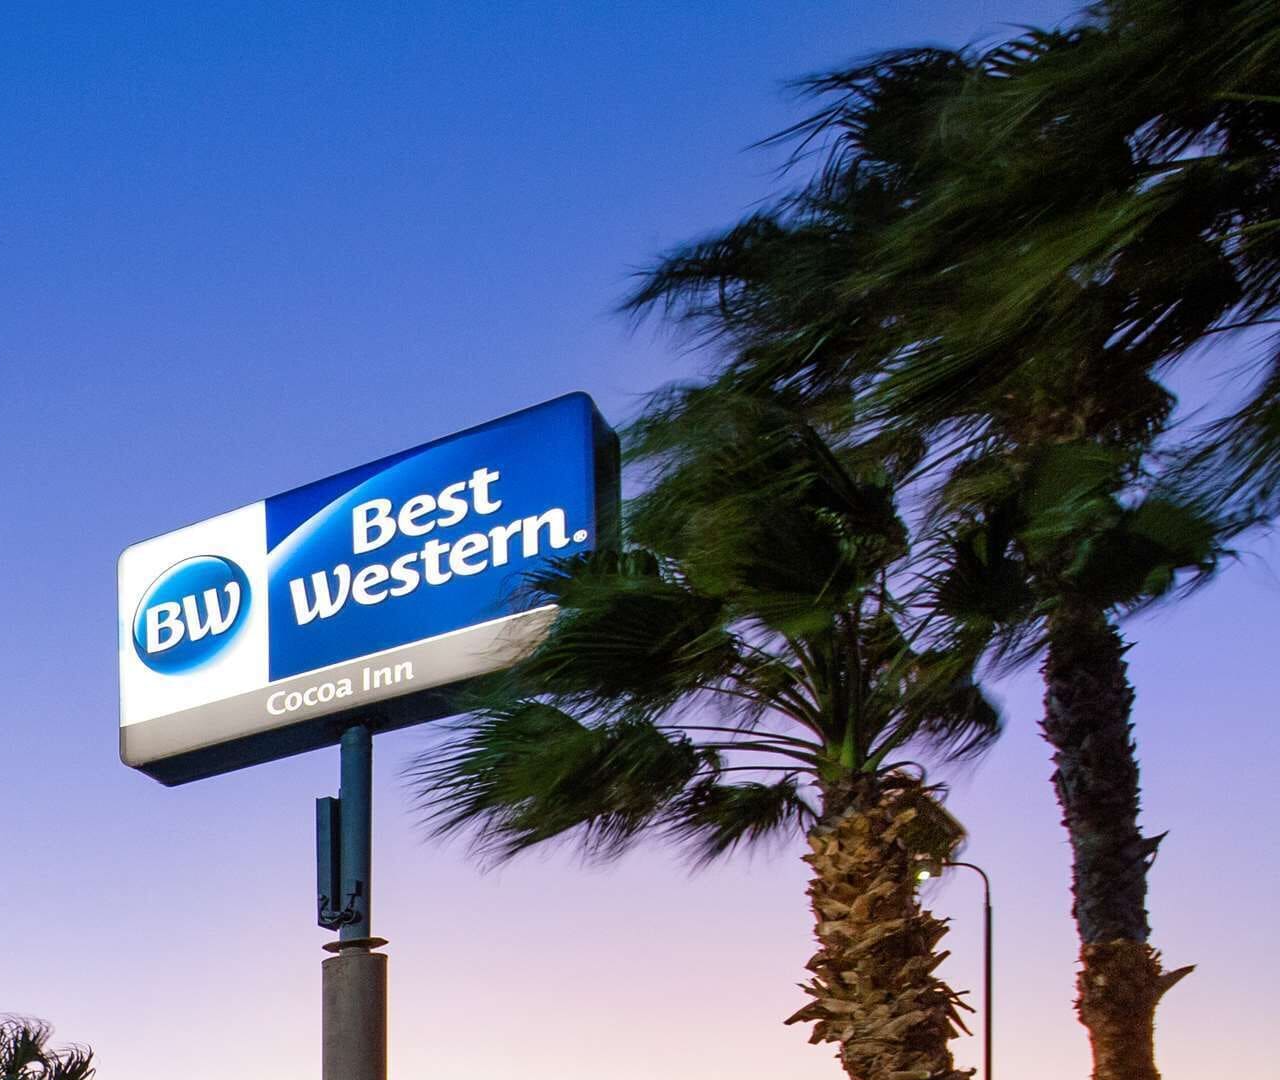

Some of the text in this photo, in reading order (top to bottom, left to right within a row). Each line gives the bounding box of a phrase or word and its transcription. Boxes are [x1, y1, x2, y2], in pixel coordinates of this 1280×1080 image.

[352, 466, 503, 554] Best
[145, 581, 241, 654] BW
[266, 660, 414, 716] Cocoa Inn
